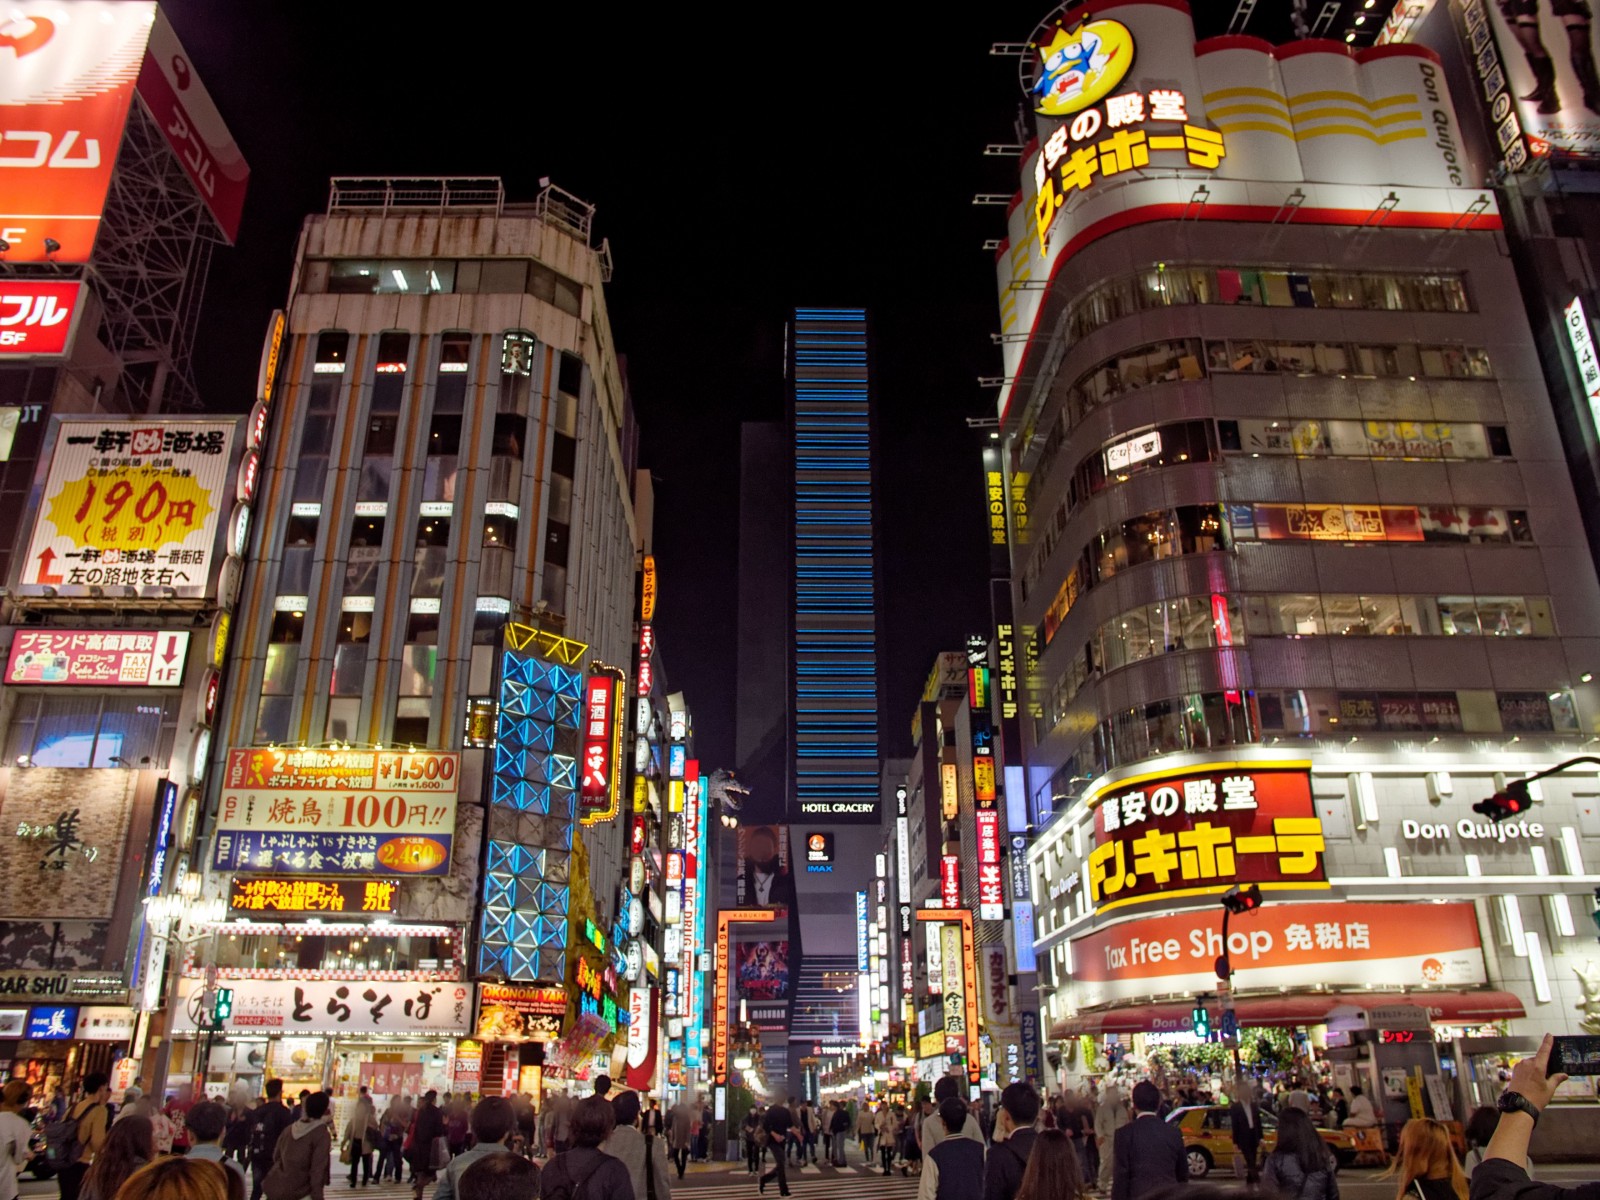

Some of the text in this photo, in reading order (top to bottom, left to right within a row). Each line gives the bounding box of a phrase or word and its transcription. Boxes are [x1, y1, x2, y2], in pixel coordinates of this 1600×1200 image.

[1419, 63, 1462, 187] Don Quijote
[0, 131, 100, 168] コム
[168, 105, 216, 198] アコム
[1035, 90, 1188, 195] 安の殿堂
[0, 296, 68, 326] フル
[0, 331, 27, 345] 5F
[21, 405, 42, 423] JT
[67, 428, 225, 456] 一軒め酒場
[74, 479, 197, 527] 190円
[987, 471, 1006, 545] 驚安の殿堂
[67, 567, 190, 586] 左の路地を右へ
[20, 634, 154, 652] ブランド高価買取
[77, 654, 116, 663] ロコシーラ
[125, 655, 148, 667] TAX
[121, 668, 146, 679] FREE
[156, 668, 178, 681] 1F
[588, 689, 608, 737] 居酒屋
[1339, 699, 1375, 718] 販売
[1381, 703, 1416, 715] ブランド
[1423, 702, 1456, 715] 時計
[272, 751, 375, 773] 2時間飲み放題
[267, 776, 374, 790] ポテトフライ食べ放題
[224, 796, 238, 822] 6F
[267, 797, 322, 826] 焼鳥
[802, 803, 874, 813] HOTEL GRACERY
[1102, 775, 1258, 832] 驚安の殿堂
[685, 781, 697, 857] SHIDAX
[1402, 819, 1545, 842] Don Quijote
[217, 836, 232, 865] 5F
[260, 833, 319, 849] しゃぶしゃぶ
[336, 835, 377, 850] すきやき
[257, 849, 376, 870] 選べる食べ放題
[807, 865, 833, 873] IMAX
[1284, 922, 1370, 951] 免税店
[1104, 928, 1273, 971] Tax Free Shop
[483, 987, 567, 1001] OKONOMI YAKI
[990, 951, 1007, 1016] カラオケ
[291, 985, 442, 1024] とらそば
[715, 933, 727, 1058] GODZILLA ROAD
[752, 1009, 786, 1019] MARUHAN
[1152, 1018, 1177, 1028] Don
[1022, 1014, 1037, 1065] カラオケ
